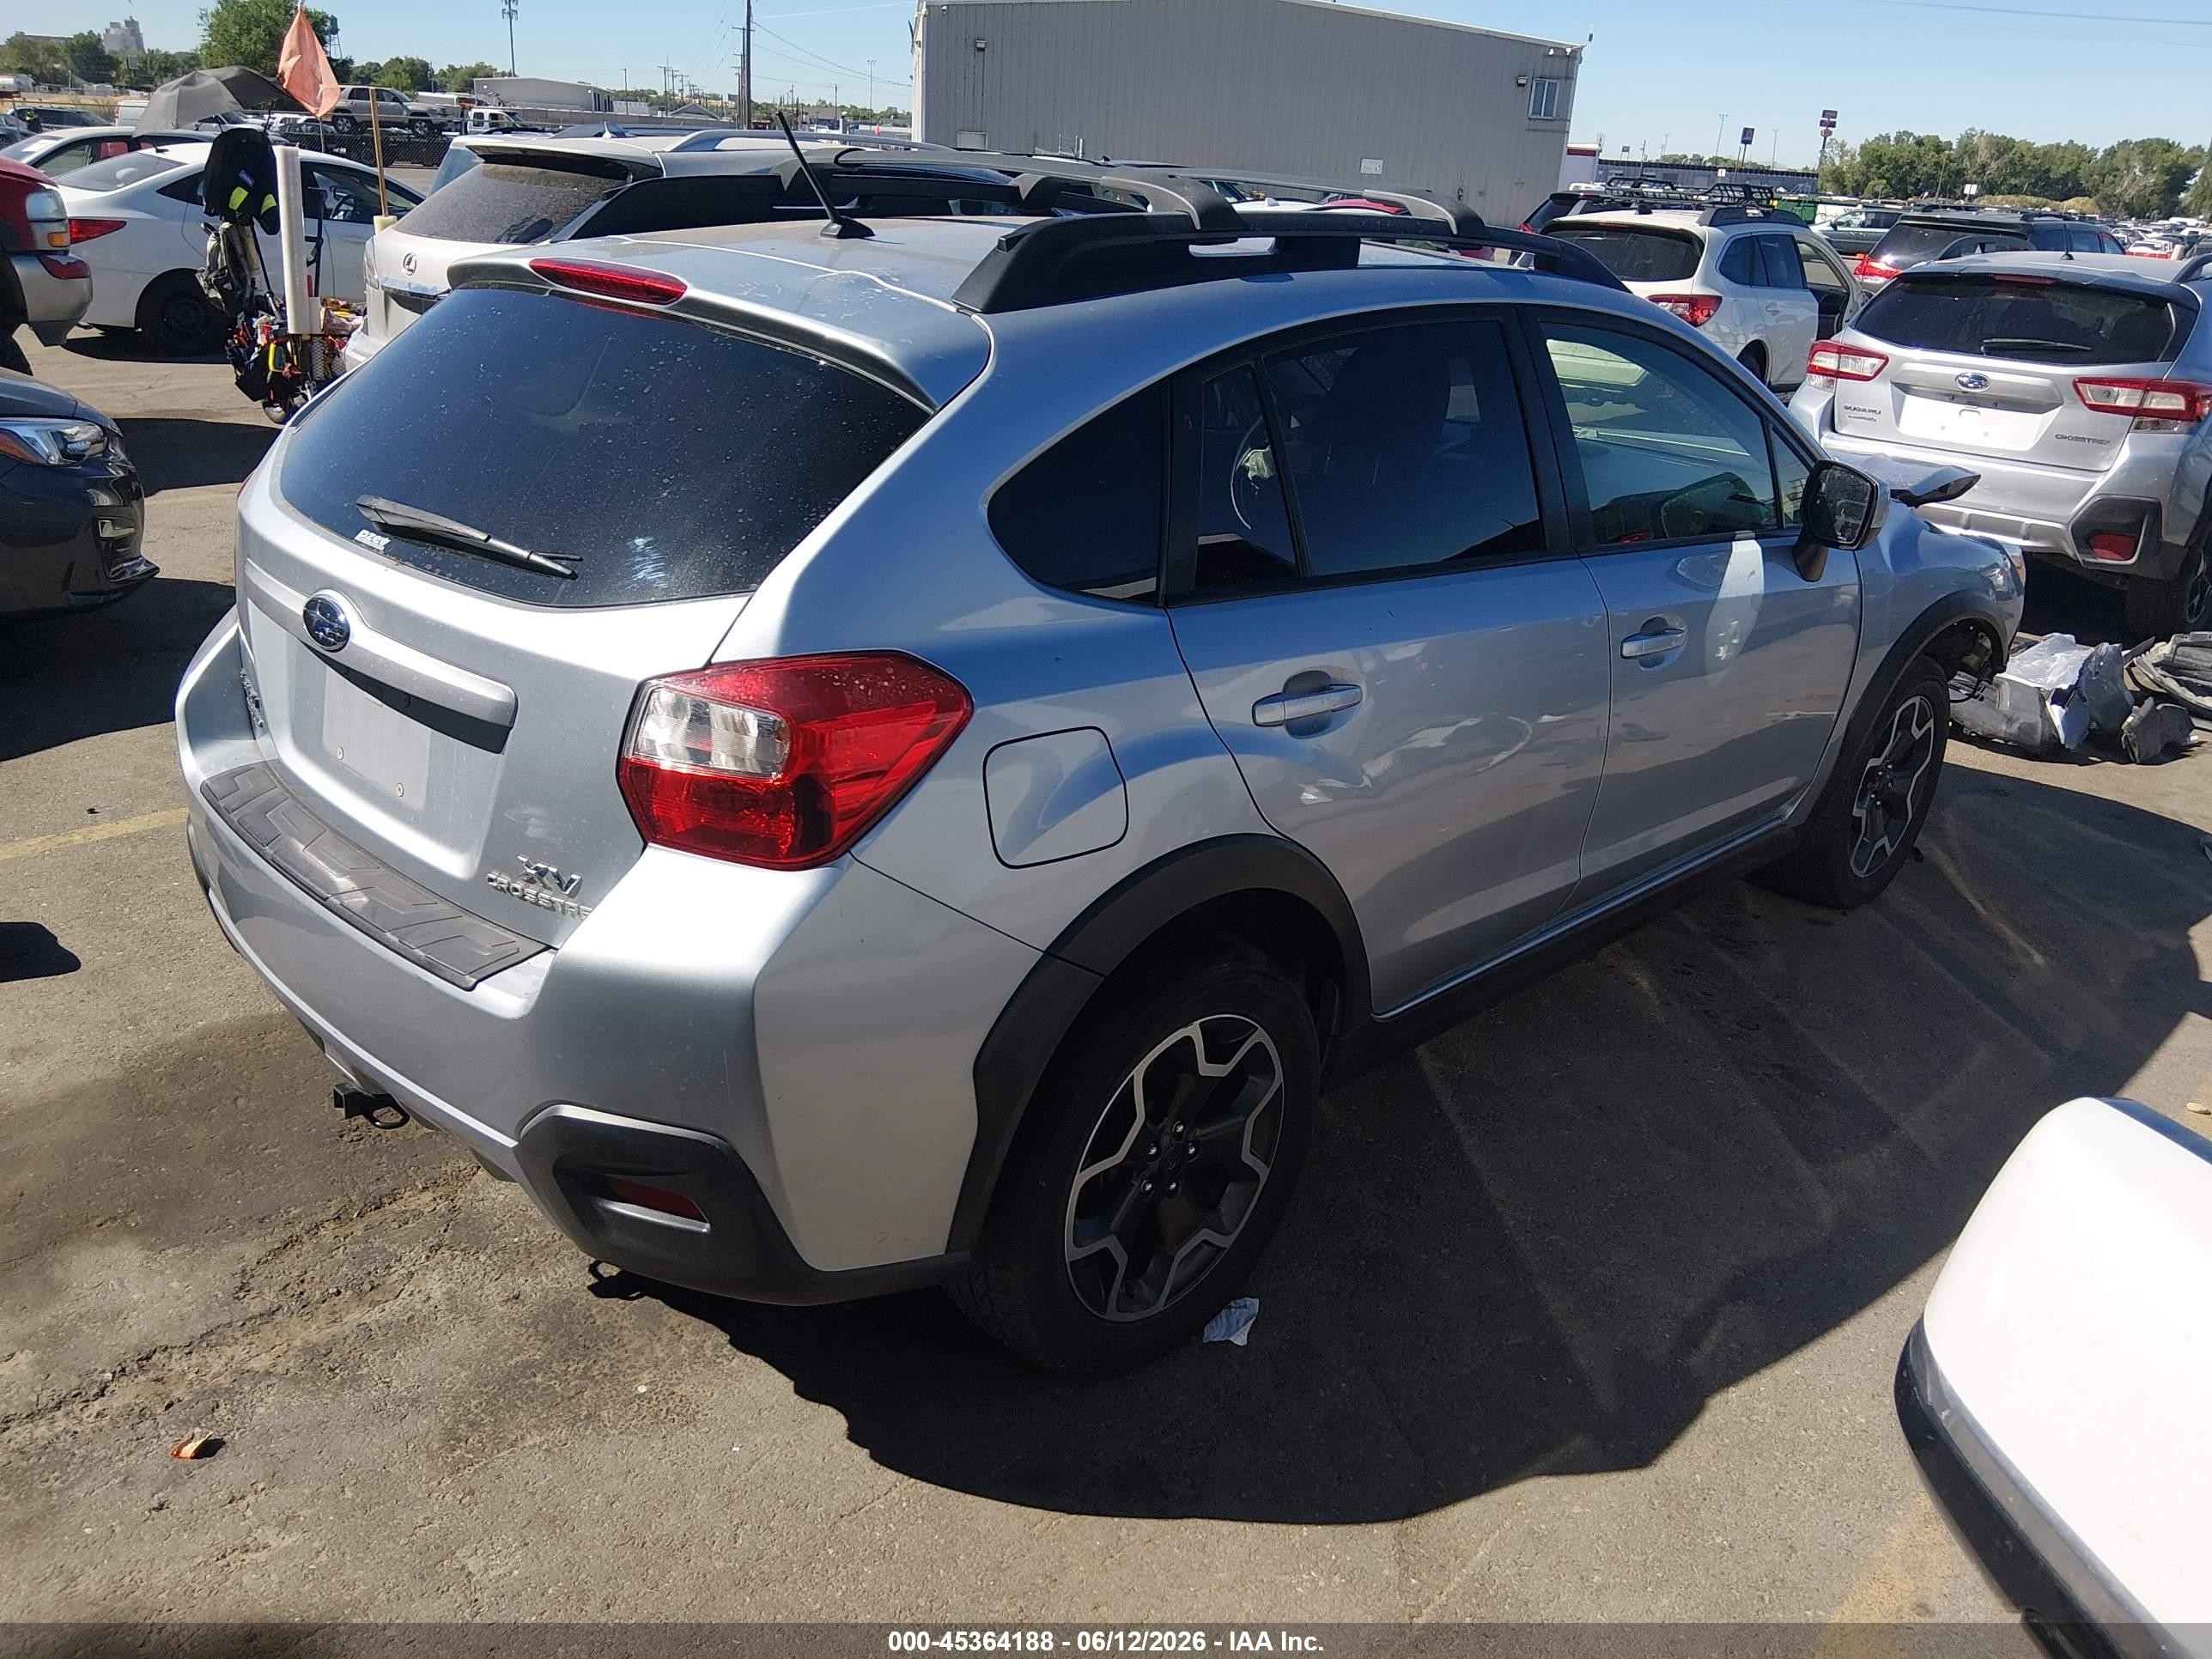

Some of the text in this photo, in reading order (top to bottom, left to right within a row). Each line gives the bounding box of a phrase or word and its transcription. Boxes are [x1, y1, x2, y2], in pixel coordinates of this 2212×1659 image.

[1844, 404, 1882, 415] SUBARU
[2055, 434, 2111, 446] CROSSTREK
[516, 854, 583, 899] XV
[487, 872, 592, 921] CROSSTRE
